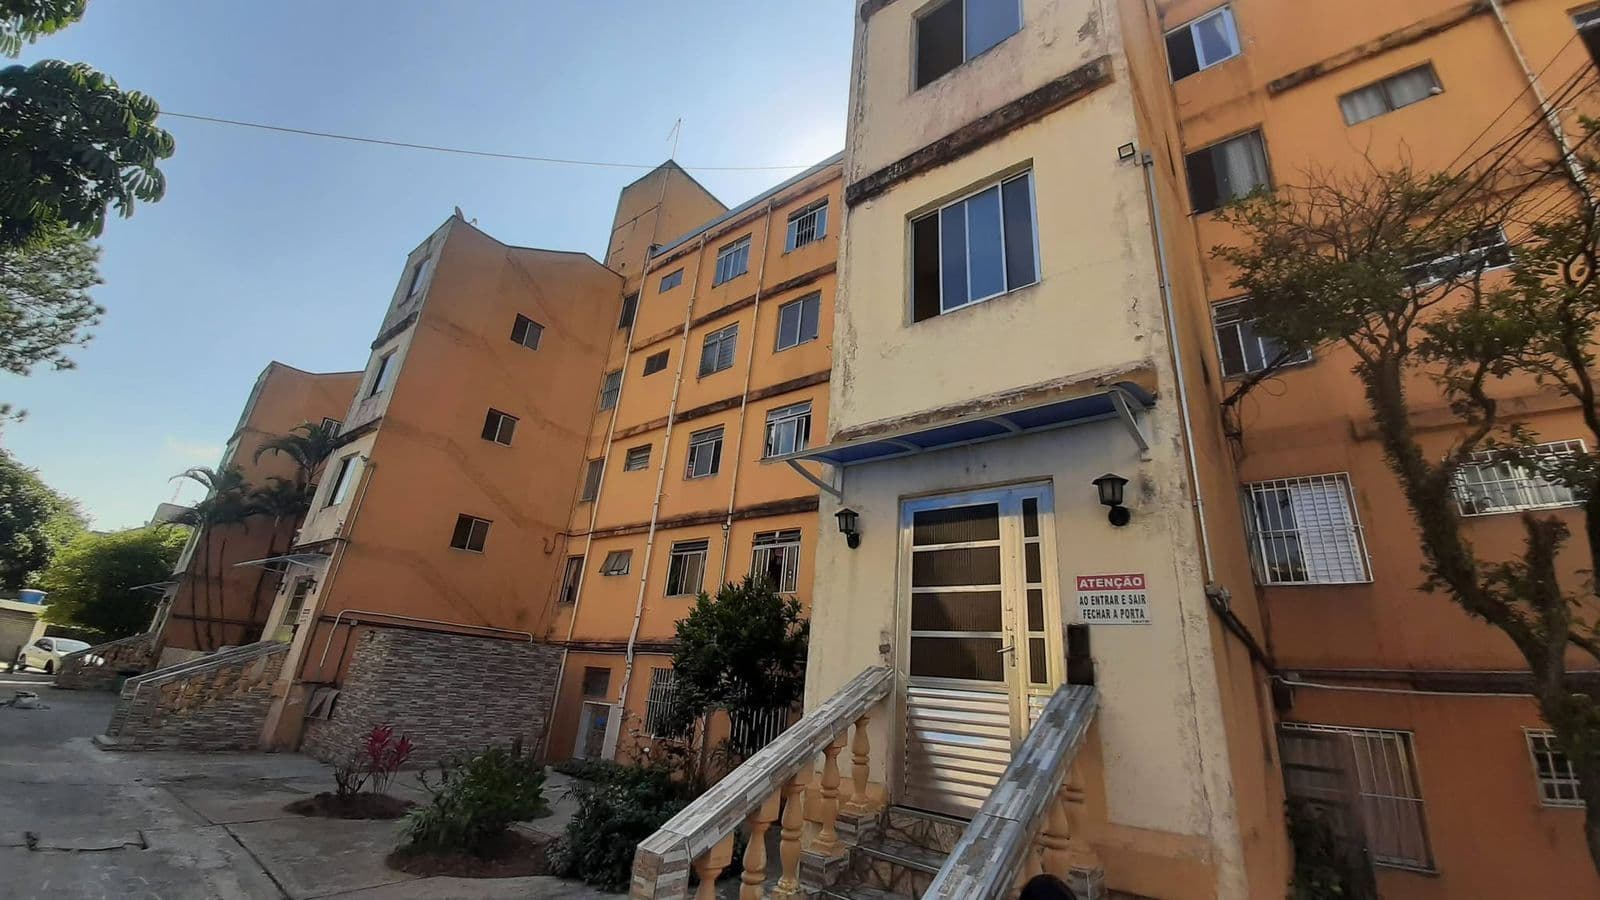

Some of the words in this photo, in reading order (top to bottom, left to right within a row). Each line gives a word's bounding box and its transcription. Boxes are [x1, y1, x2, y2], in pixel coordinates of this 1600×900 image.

[1080, 576, 1142, 589] ATENÇÃO
[1079, 595, 1089, 605] AO
[1090, 595, 1120, 605] ENTRAR
[1121, 594, 1127, 605] E
[1128, 594, 1146, 605] SAIR
[1082, 609, 1111, 619] FECHAR
[1113, 609, 1119, 619] A
[1120, 608, 1145, 619] PORTA
